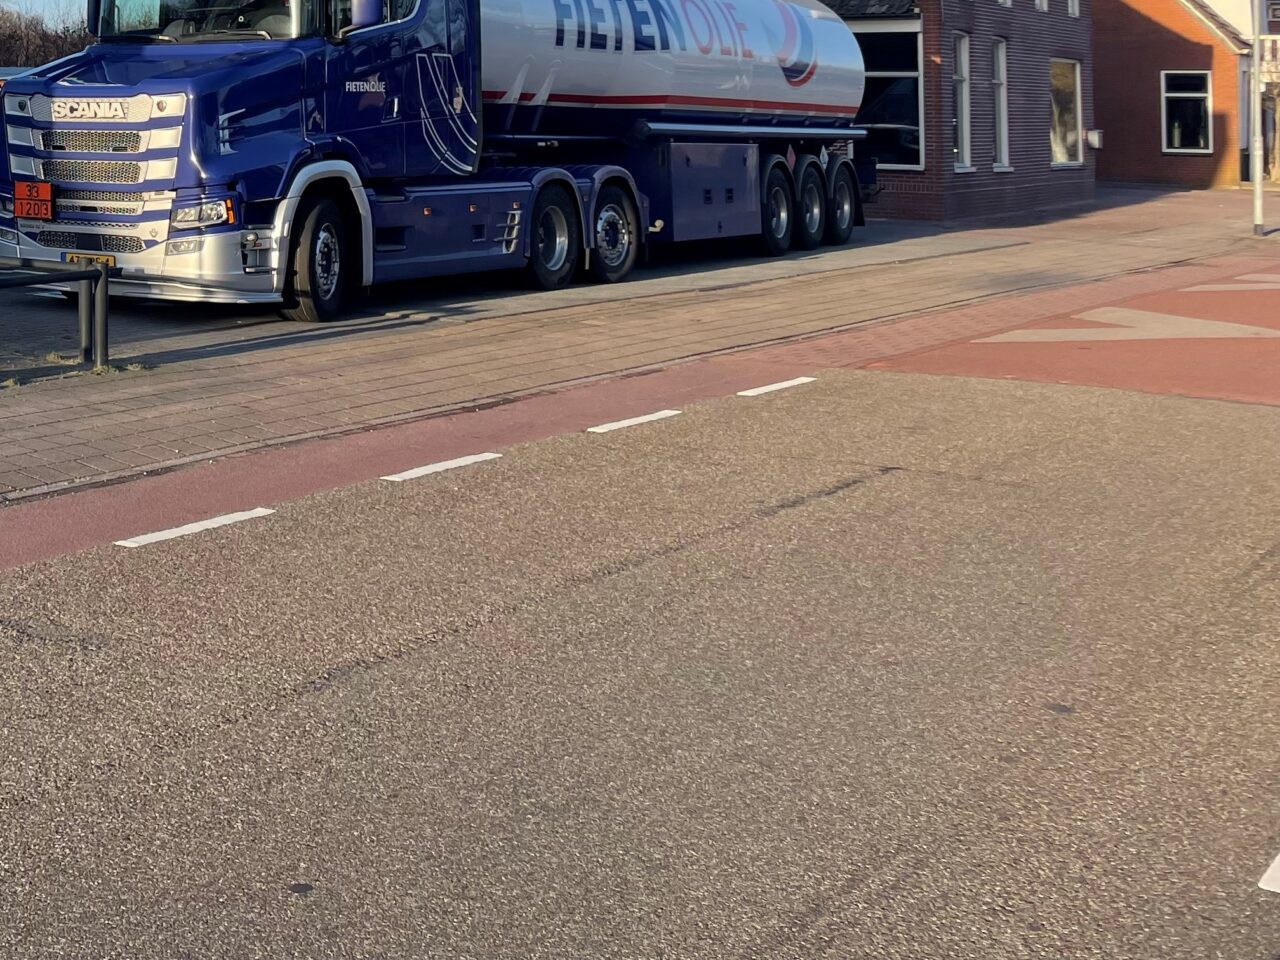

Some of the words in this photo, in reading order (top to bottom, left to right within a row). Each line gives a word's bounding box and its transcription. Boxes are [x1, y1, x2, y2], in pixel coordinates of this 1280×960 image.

[53, 101, 125, 119] SCANIA
[26, 184, 40, 198] 33
[20, 201, 49, 216] 1203
